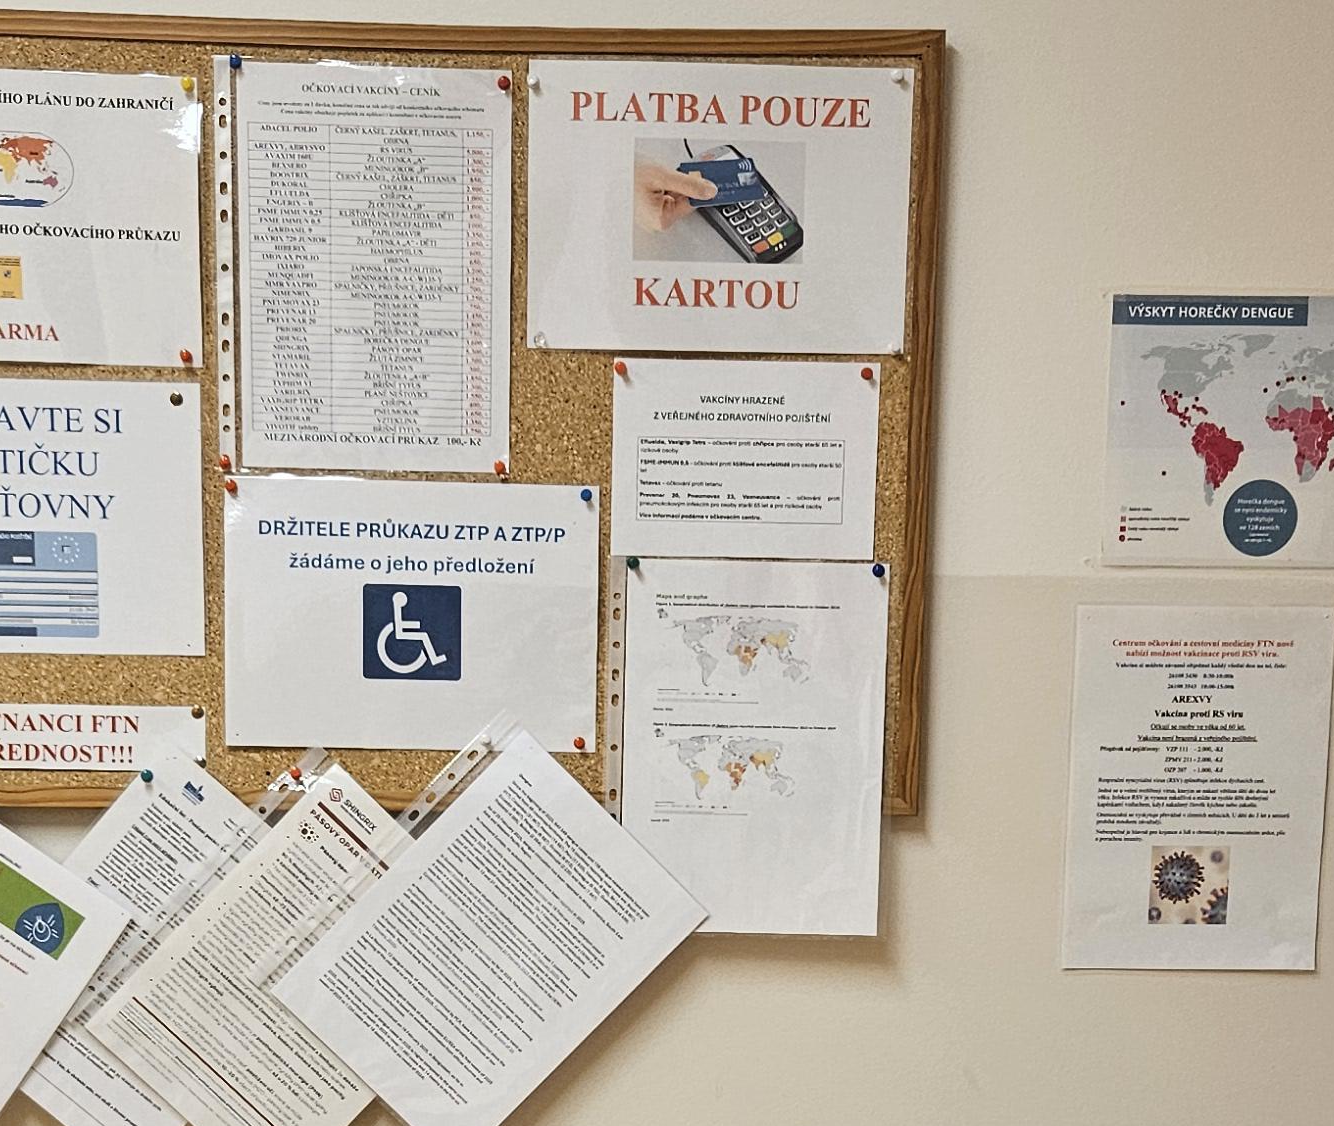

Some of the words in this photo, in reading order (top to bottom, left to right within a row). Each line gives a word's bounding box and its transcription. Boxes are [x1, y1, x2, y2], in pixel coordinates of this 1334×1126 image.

[302, 83, 354, 93] OČKOVACÍ
[356, 85, 399, 96] VAKCÍNY
[410, 85, 441, 97] CENÍK
[26, 92, 72, 107] PLÁNU
[75, 96, 95, 107] DO
[98, 97, 174, 111] ZAHRANIČÍ
[570, 91, 727, 125] PLATBA
[740, 95, 870, 128] POUZE
[23, 222, 114, 239] OČKOVACÍHO
[118, 226, 181, 242] PRŮKAZU
[633, 277, 800, 309] KARTOU
[1129, 304, 1176, 318] VÝSKYT
[1179, 303, 1239, 319] HOREČKY
[1241, 306, 1294, 320] DENGUE
[700, 395, 740, 404] VAKCÍNY
[742, 395, 785, 405] HRAZENÉ
[94, 409, 123, 434] SI
[654, 412, 659, 420] Z
[661, 411, 715, 421] VEŘEJNÉHO
[717, 412, 783, 422] ZDRAVOTNÍHO
[785, 412, 831, 423] POJIŠTĚNÍ
[265, 431, 337, 442] MEZINÁRODNÍ
[340, 432, 395, 444] OČKOVACÍ
[258, 517, 350, 537] DRŽITELE
[356, 519, 449, 540] PRŮKAZU
[454, 525, 489, 541] ZTP
[494, 526, 507, 541] A
[511, 526, 565, 543] ZTP/P
[289, 553, 364, 571] žádáme
[370, 559, 382, 571] o
[386, 556, 428, 574] jeho
[434, 557, 534, 575] předložení
[1112, 639, 1146, 647] Centrum
[1148, 639, 1182, 647] očkování
[1222, 651, 1240, 659] proti
[1172, 696, 1212, 704] AREXVY
[91, 715, 140, 734] FTN
[1155, 710, 1188, 718] Vakcína
[1190, 710, 1210, 720] proti
[1213, 710, 1224, 718] RS
[1227, 710, 1243, 718] viru
[344, 799, 377, 831] SHINGRIX
[310, 809, 340, 837] PÁSOVÝ
[339, 838, 359, 858] OPAR
